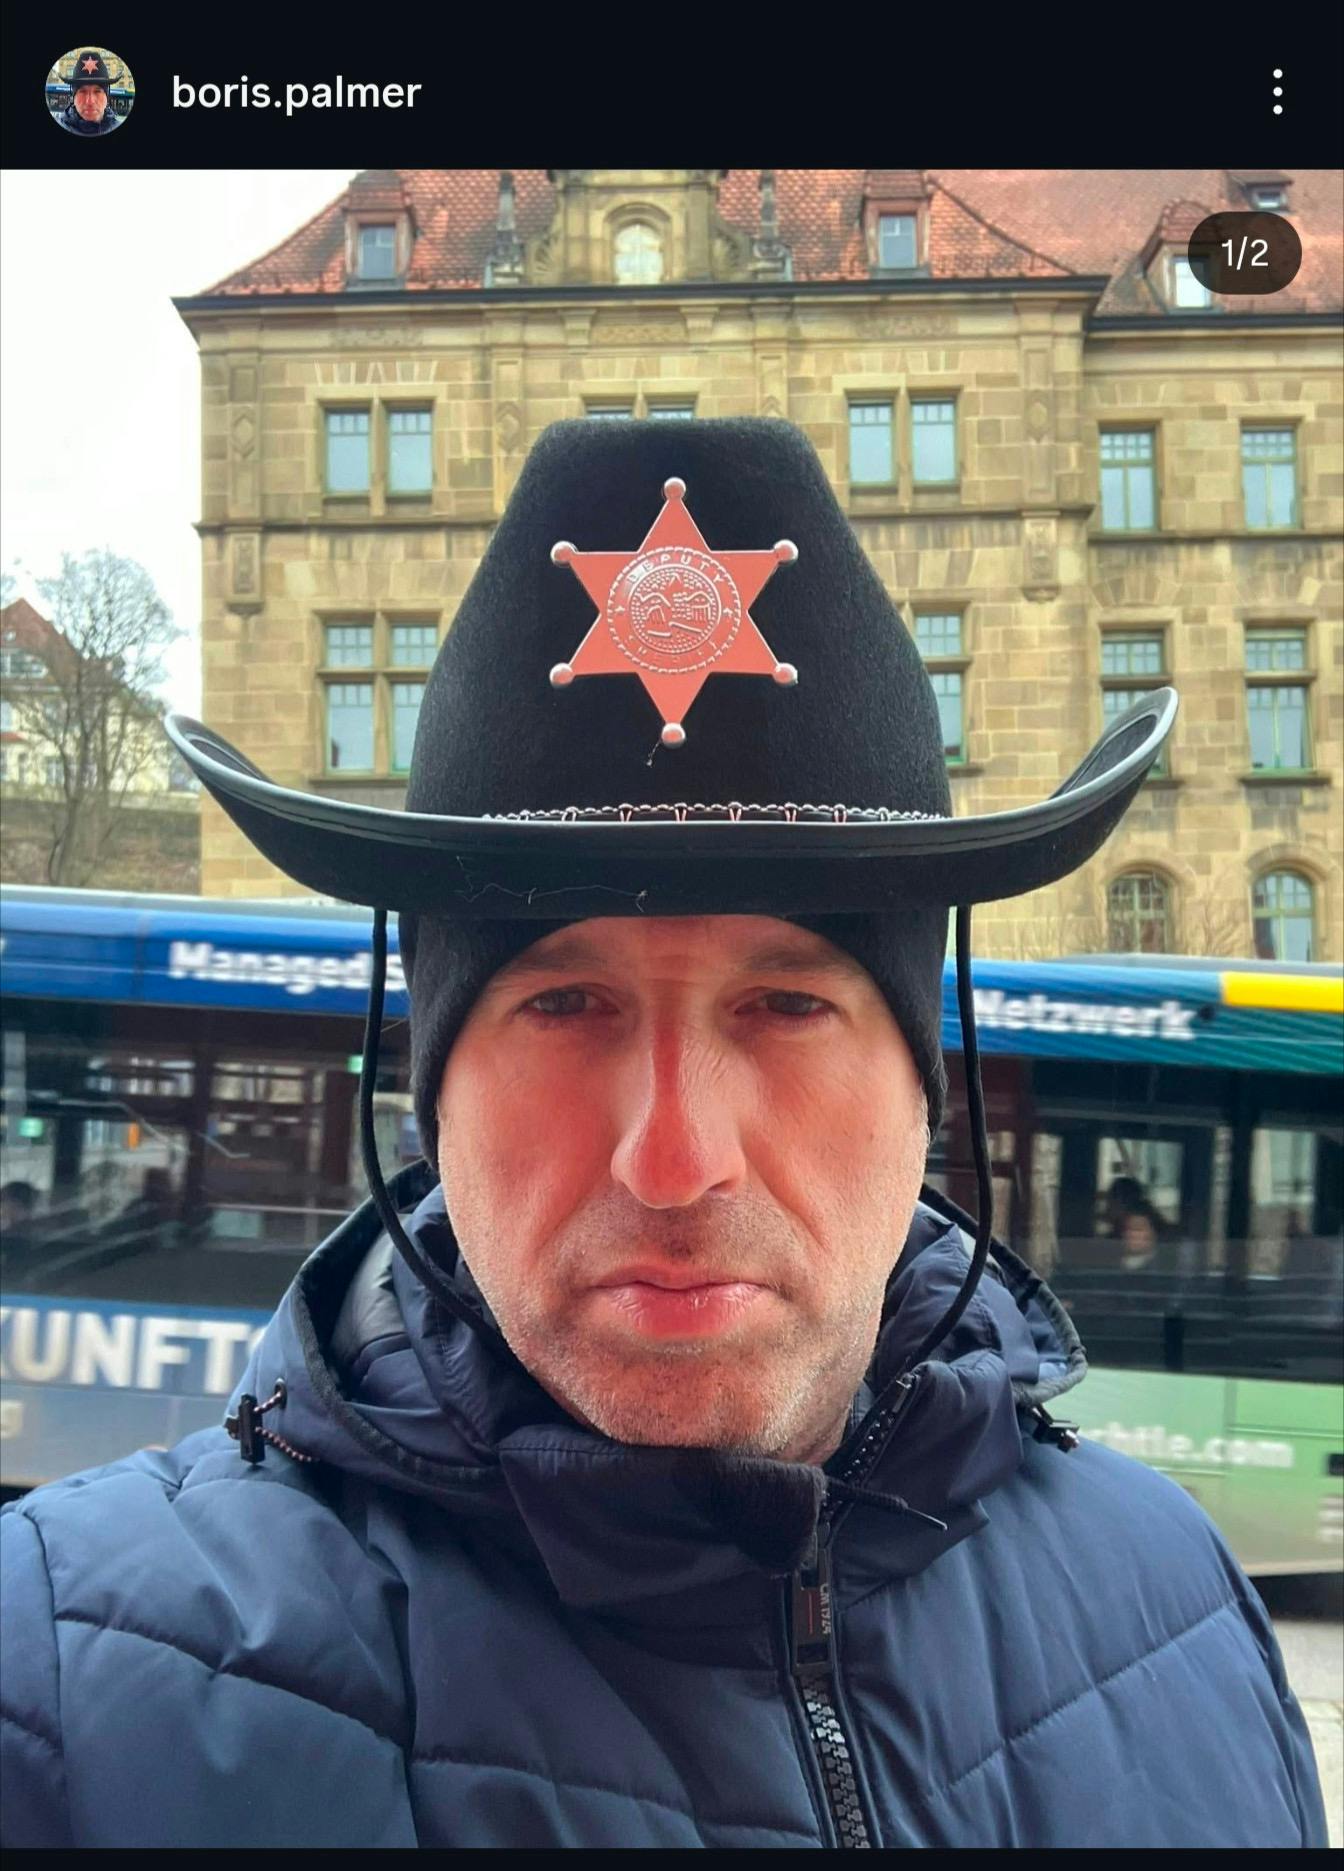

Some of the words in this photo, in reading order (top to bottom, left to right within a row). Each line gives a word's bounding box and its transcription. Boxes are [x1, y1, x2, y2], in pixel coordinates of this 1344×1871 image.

[626, 554, 724, 584] DEPUTY
[168, 941, 372, 995] Managed
[972, 988, 1197, 1041] Netzwerk
